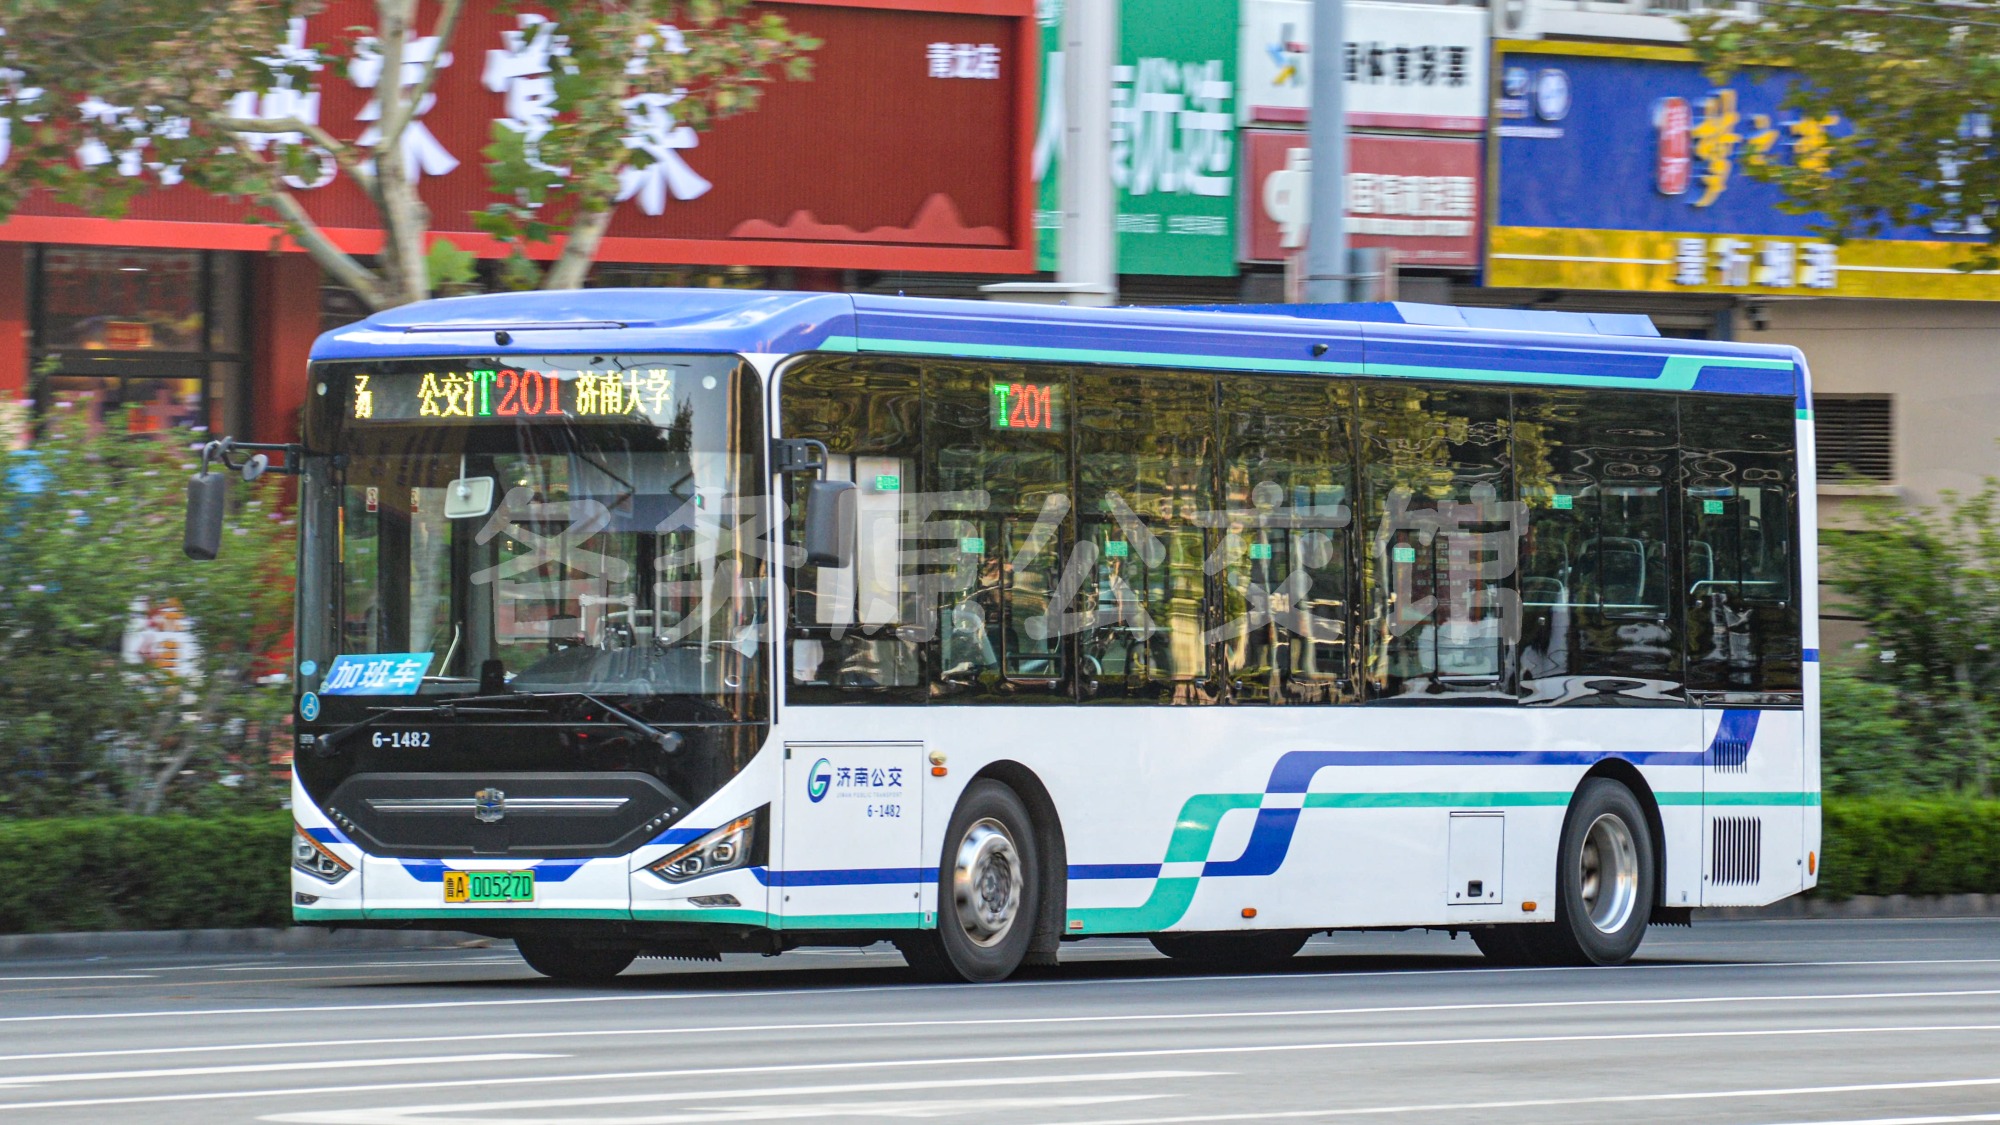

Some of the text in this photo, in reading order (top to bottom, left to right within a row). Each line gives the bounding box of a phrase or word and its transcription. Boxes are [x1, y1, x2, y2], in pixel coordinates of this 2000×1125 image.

[575, 369, 671, 415] 济南大学
[994, 383, 1051, 429] T201
[329, 659, 421, 688] 加班车
[371, 731, 431, 748] 6-1482
[836, 767, 903, 787] 济南公交
[867, 804, 901, 818] 6-1482
[473, 875, 531, 897] 00527D
